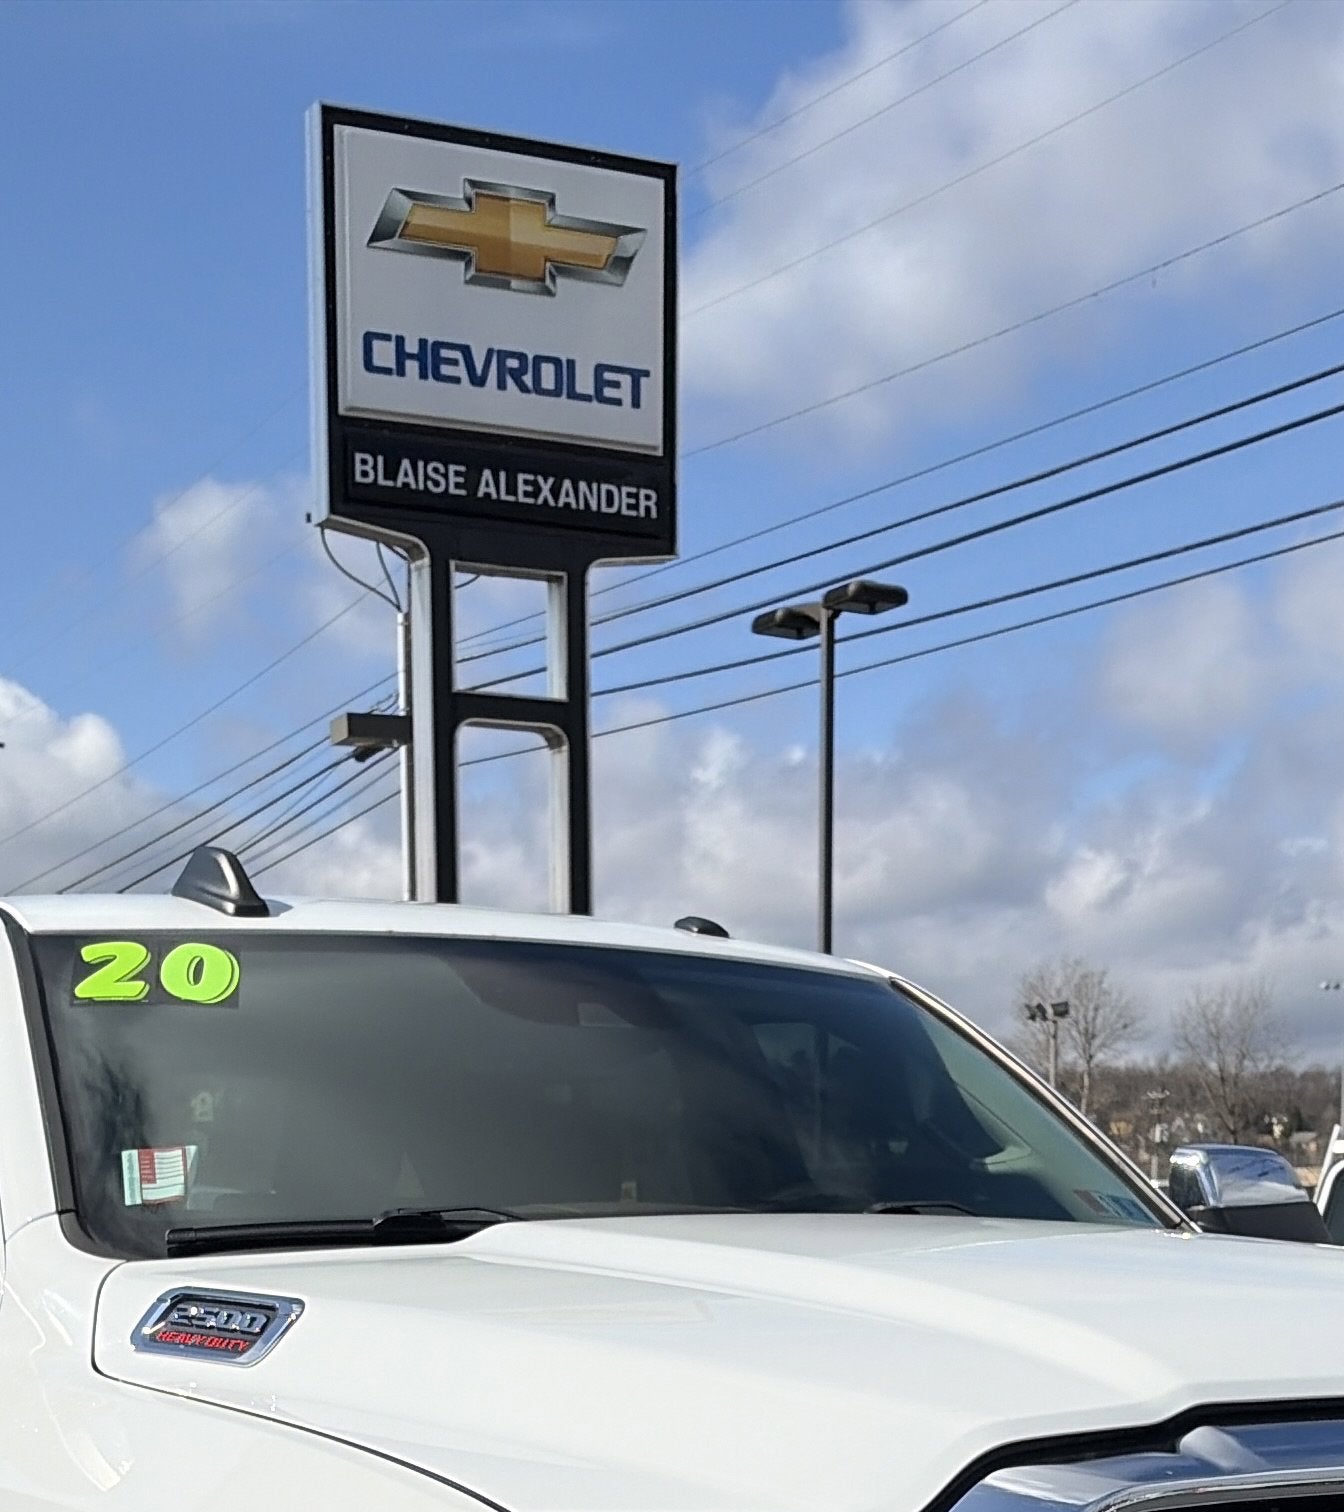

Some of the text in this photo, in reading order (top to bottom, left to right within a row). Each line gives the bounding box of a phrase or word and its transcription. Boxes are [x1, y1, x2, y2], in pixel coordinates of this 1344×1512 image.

[362, 330, 651, 409] CHEVROLET
[354, 452, 658, 519] BLAISE ALEXANDER
[74, 941, 240, 1004] 20
[156, 1331, 250, 1352] HEAVY DUTY
[170, 1303, 268, 1333] 2500
